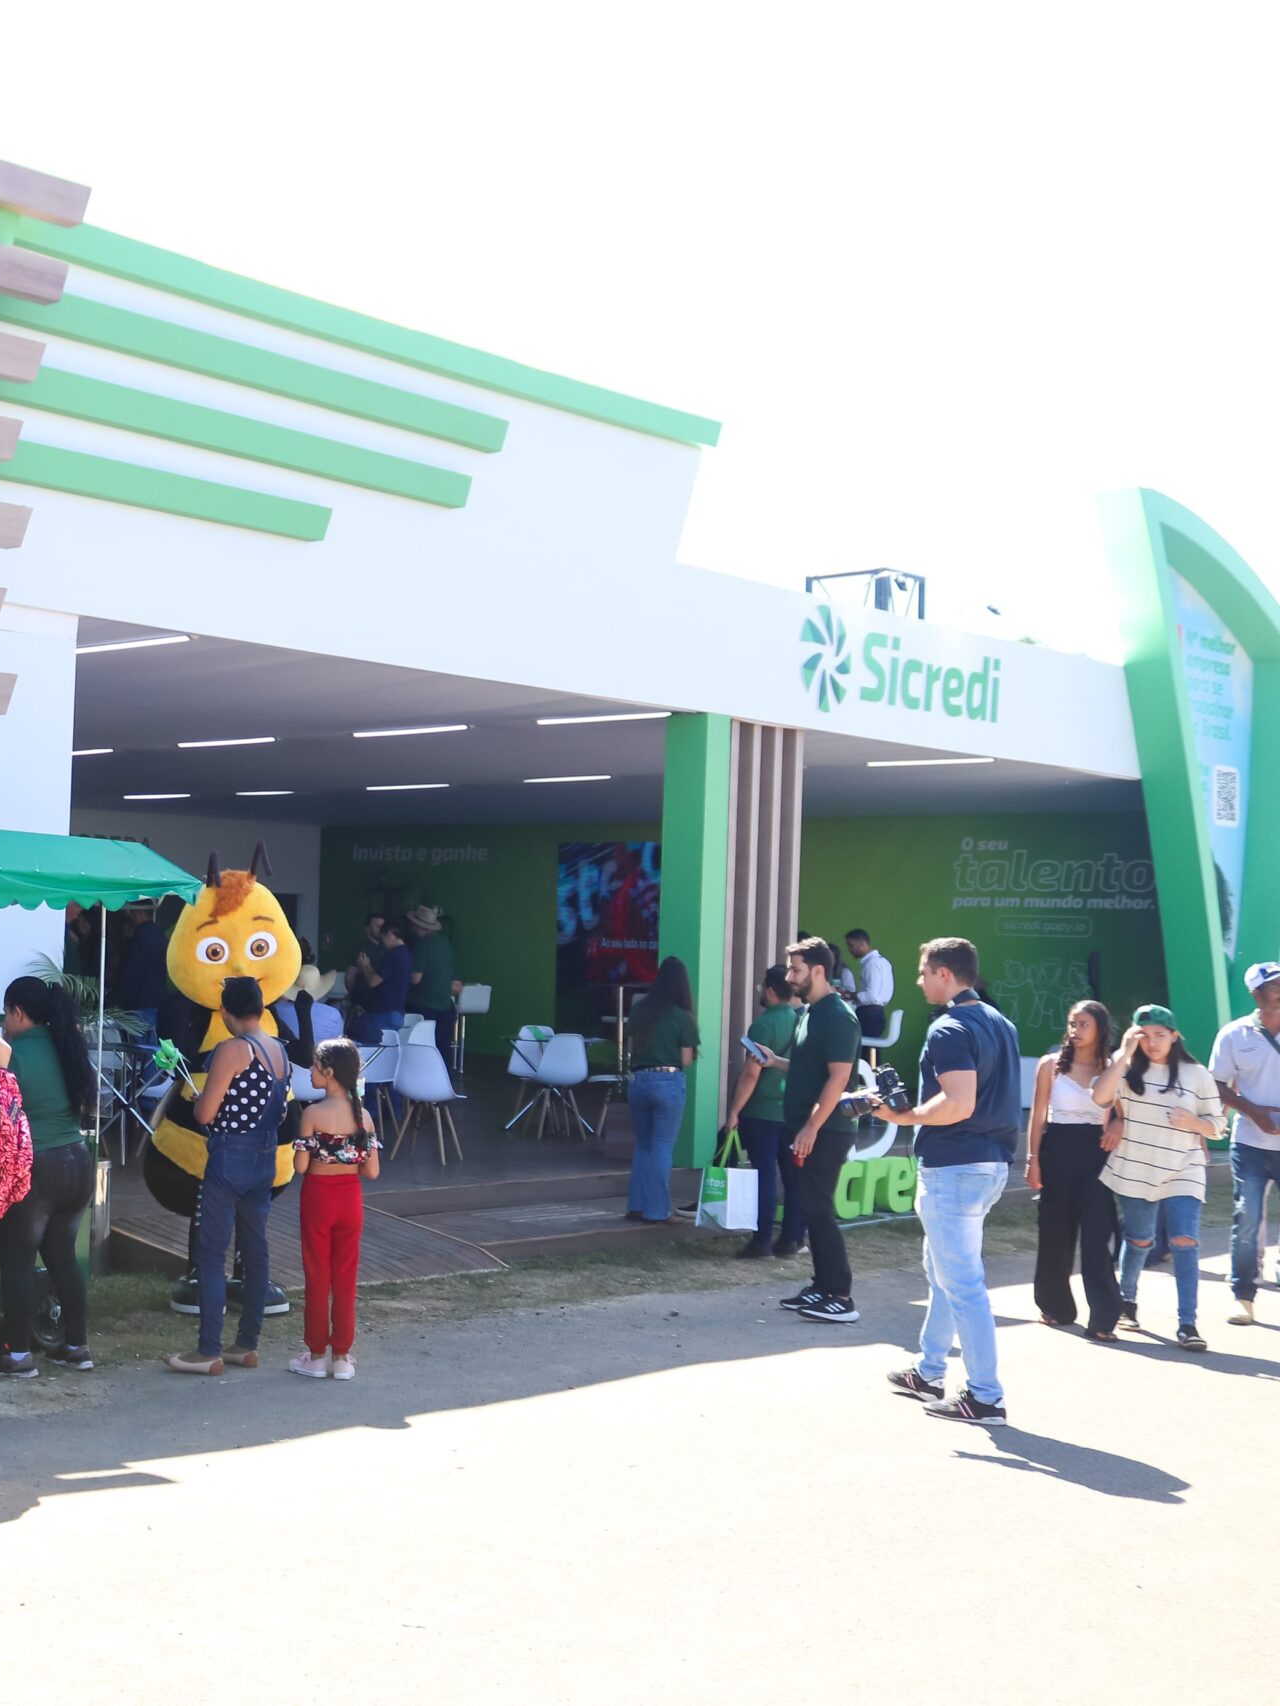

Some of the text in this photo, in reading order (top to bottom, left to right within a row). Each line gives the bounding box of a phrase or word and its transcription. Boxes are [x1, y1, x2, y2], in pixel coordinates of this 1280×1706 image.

[860, 631, 1002, 723] Sicredi
[1191, 699, 1235, 720] rabalhar
[353, 842, 489, 867] Invista e ganhe
[961, 837, 1009, 851] O seu
[954, 849, 1157, 893] talento
[952, 895, 1155, 910] para um mundo melhor.
[1003, 919, 1087, 933] sicredi.gupy.io
